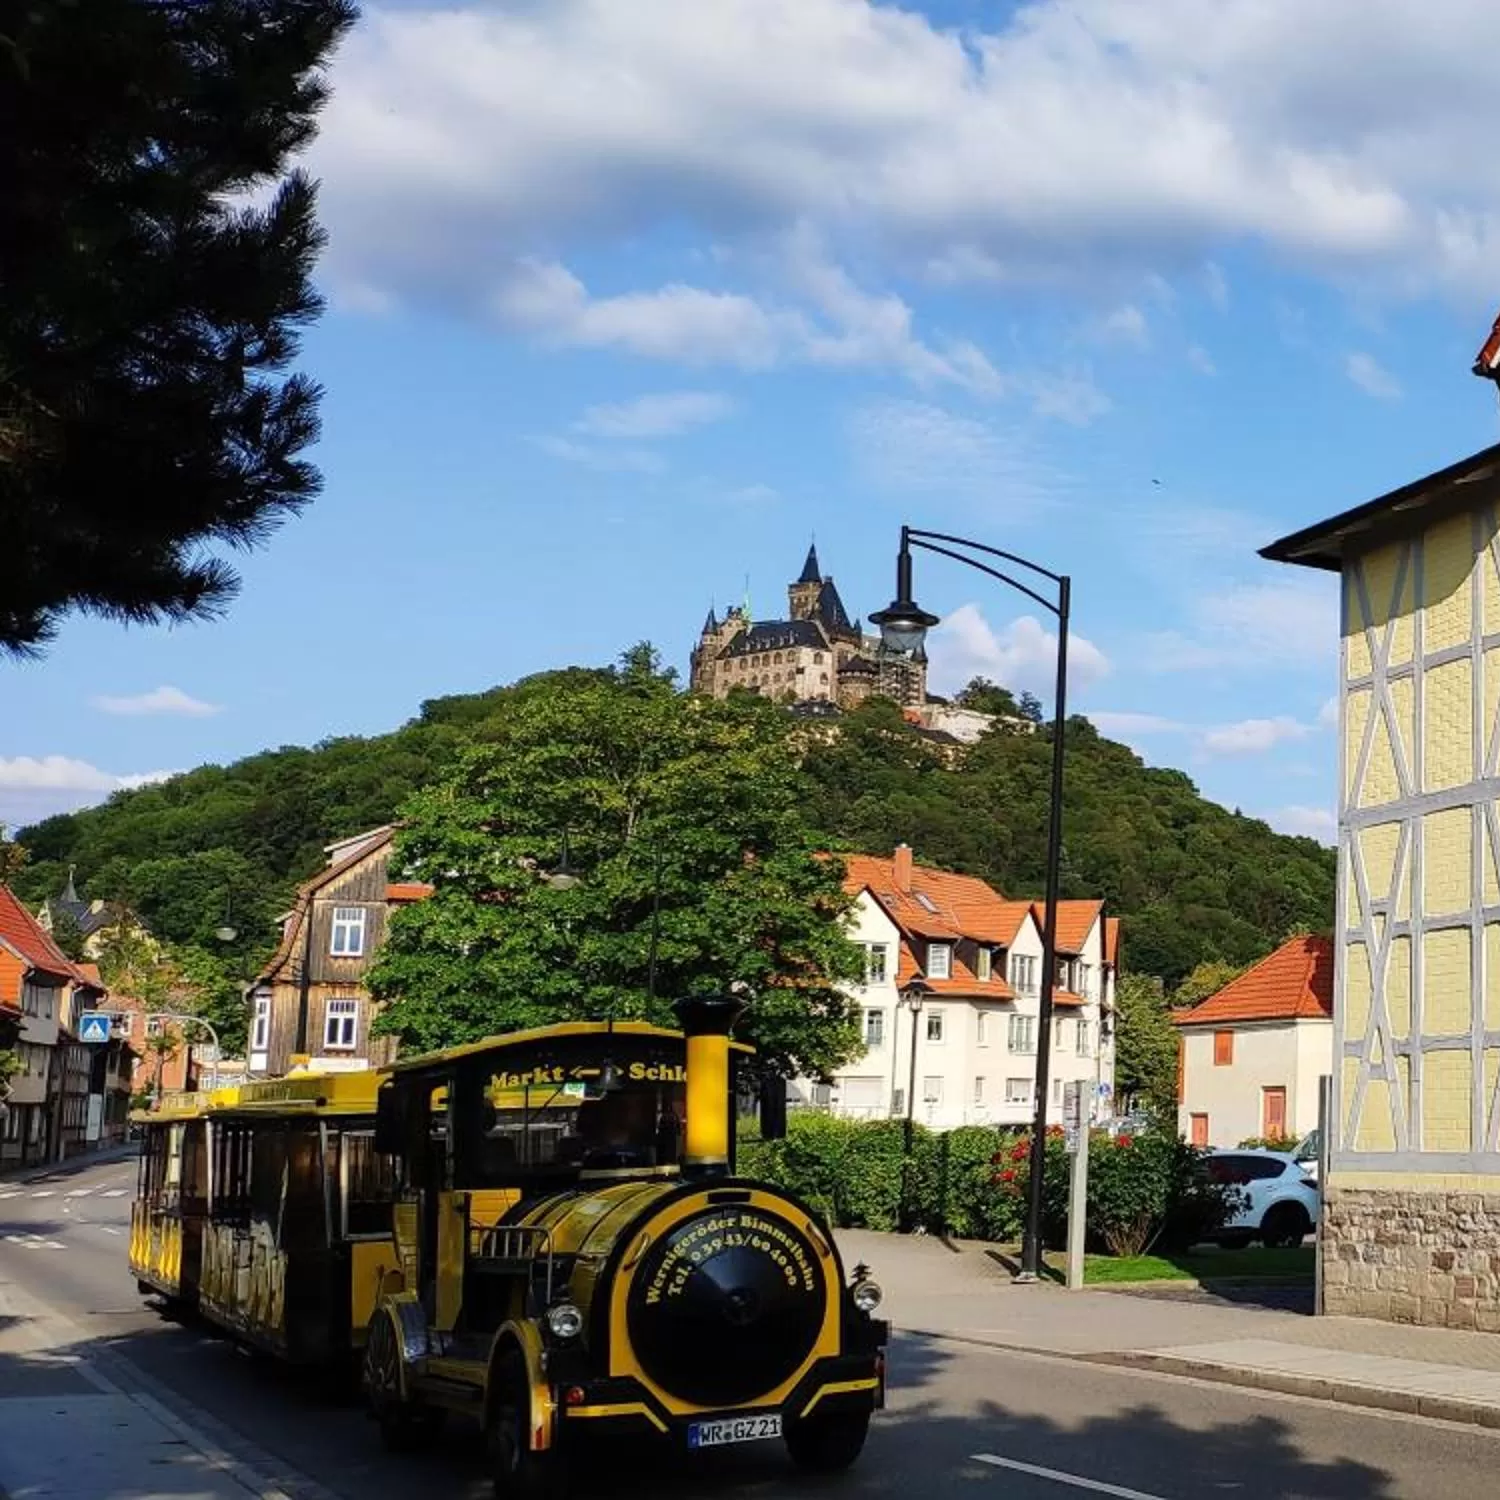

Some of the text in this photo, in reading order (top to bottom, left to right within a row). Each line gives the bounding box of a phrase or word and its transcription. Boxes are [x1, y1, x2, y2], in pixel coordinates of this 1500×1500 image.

[491, 1064, 564, 1090] Markt
[646, 1215, 815, 1305] Wernigeröder Bimmelbahn
[667, 1265, 693, 1297] Tel.
